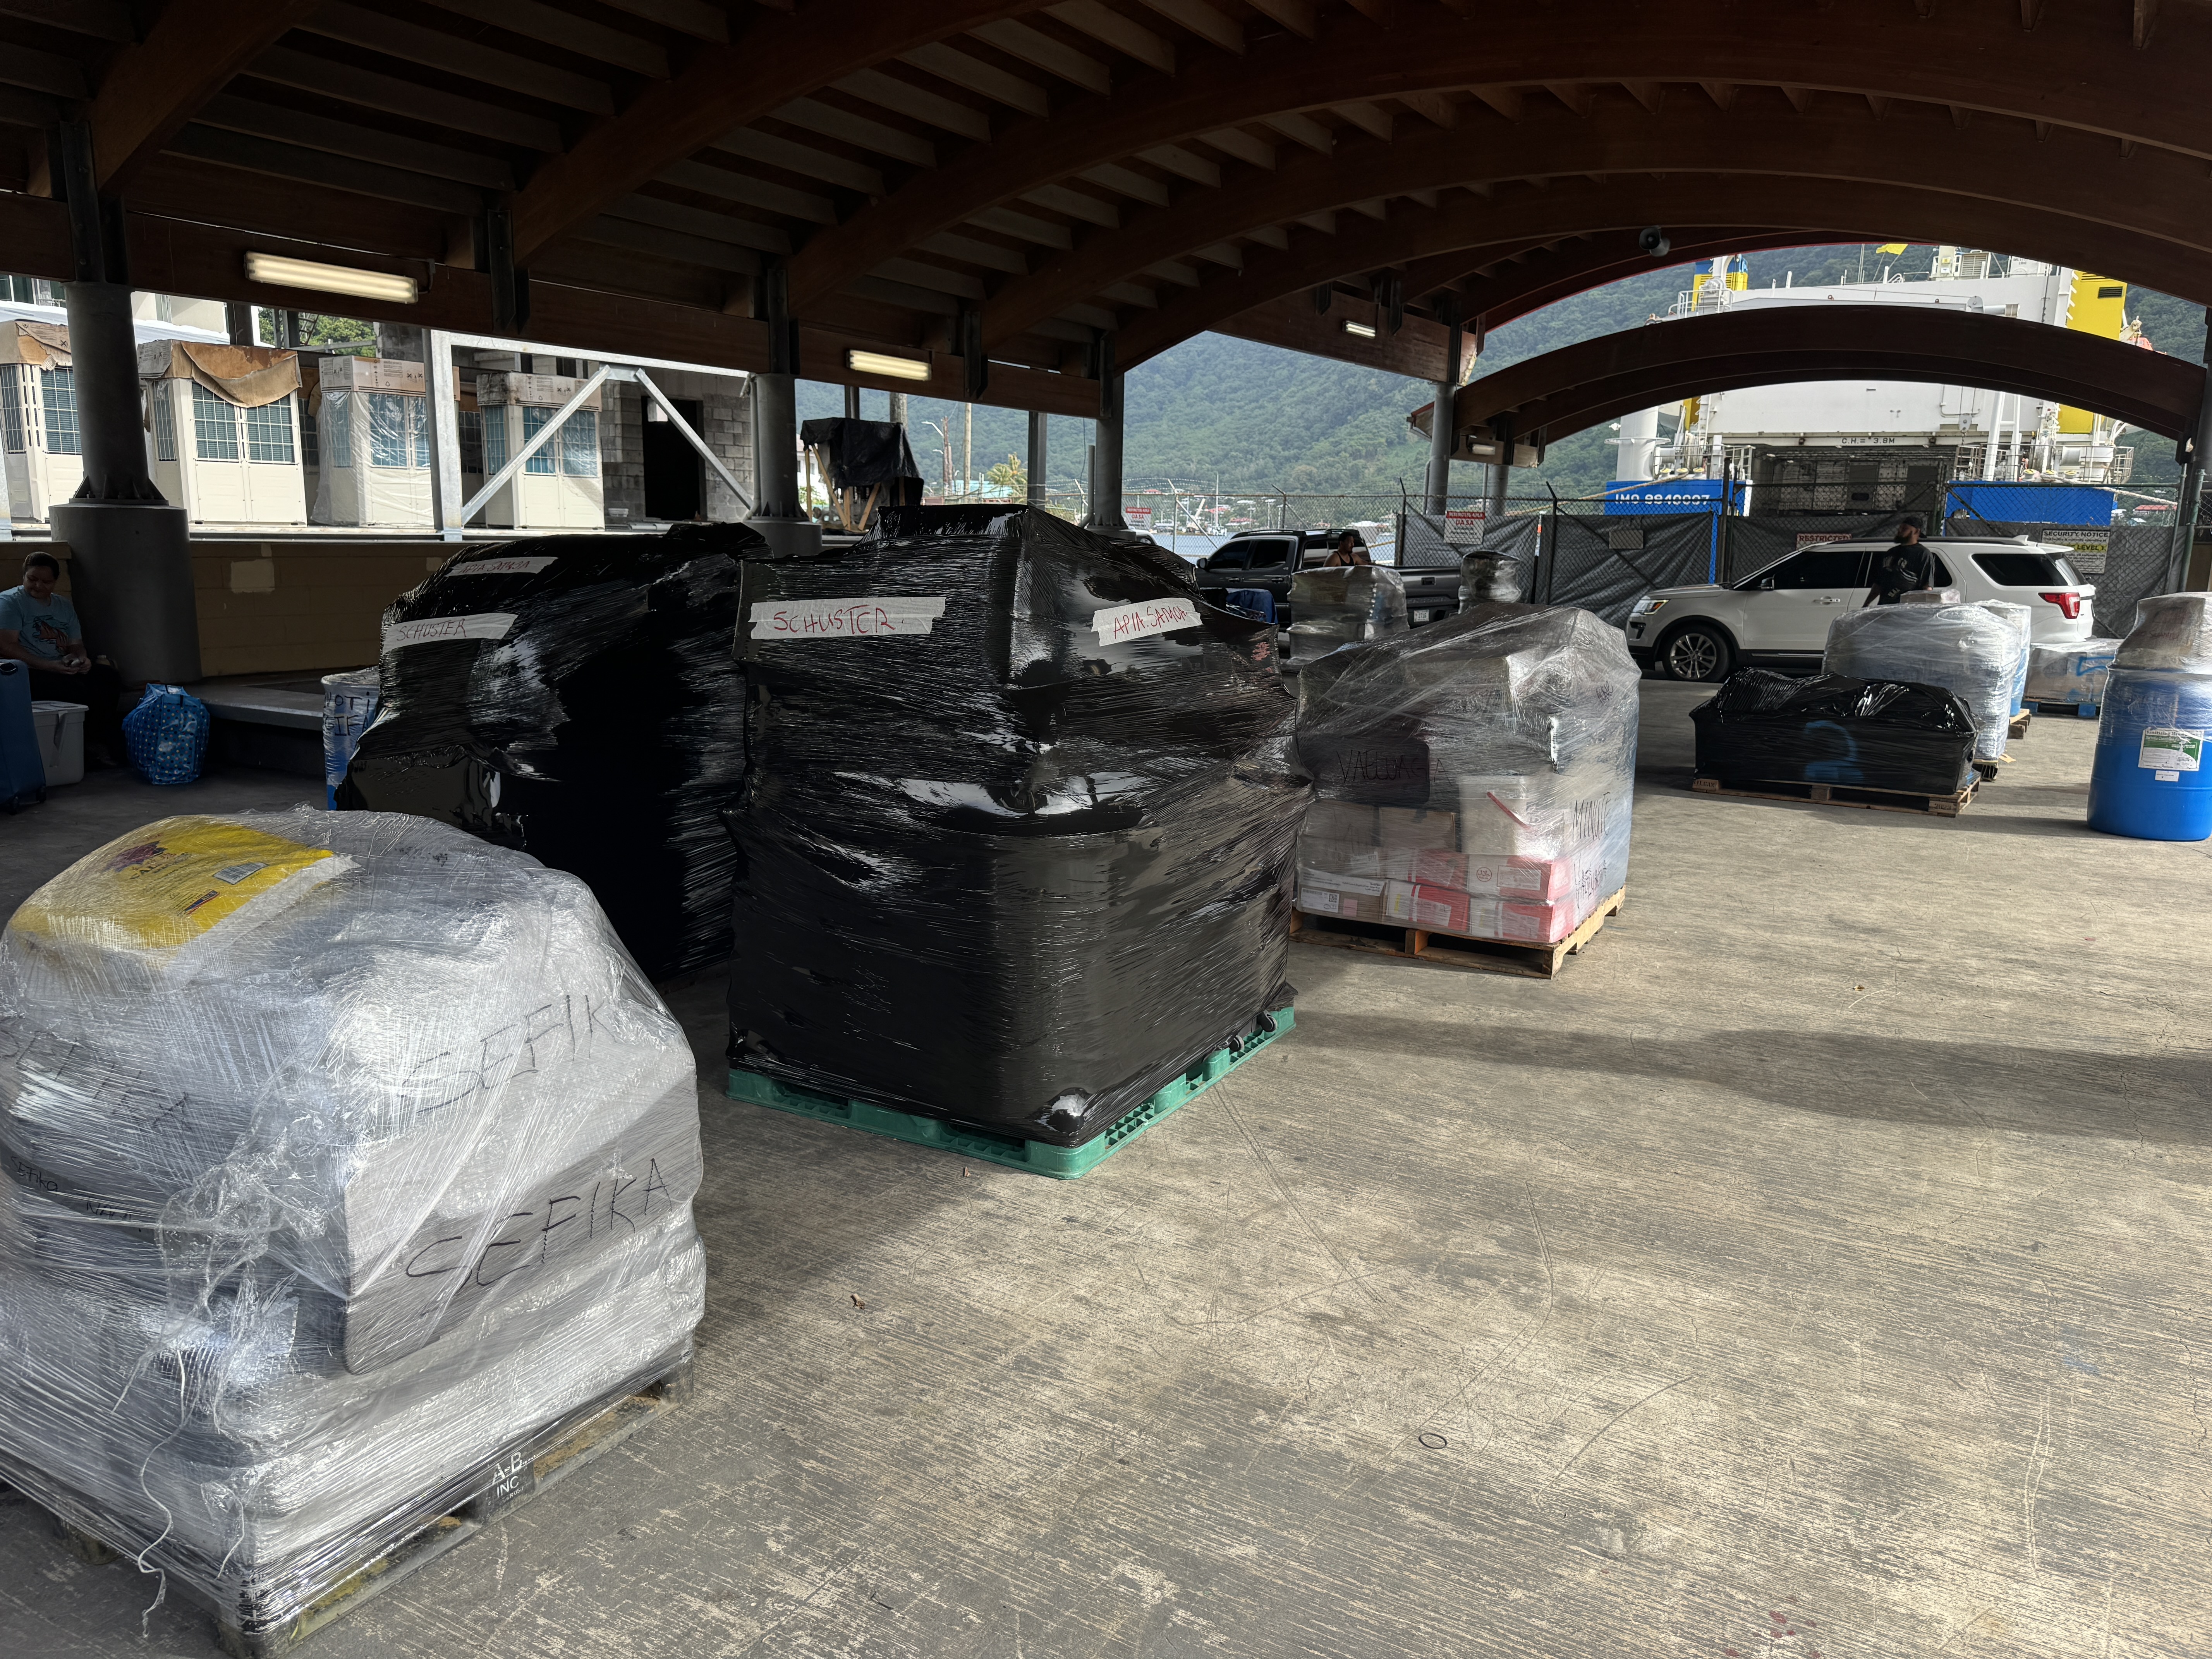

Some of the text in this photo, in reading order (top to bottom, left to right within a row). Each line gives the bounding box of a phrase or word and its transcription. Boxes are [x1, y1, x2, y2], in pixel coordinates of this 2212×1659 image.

[1615, 494, 1640, 504] IMO
[397, 618, 467, 641] SCHUSTER
[496, 1476, 519, 1498] INC
